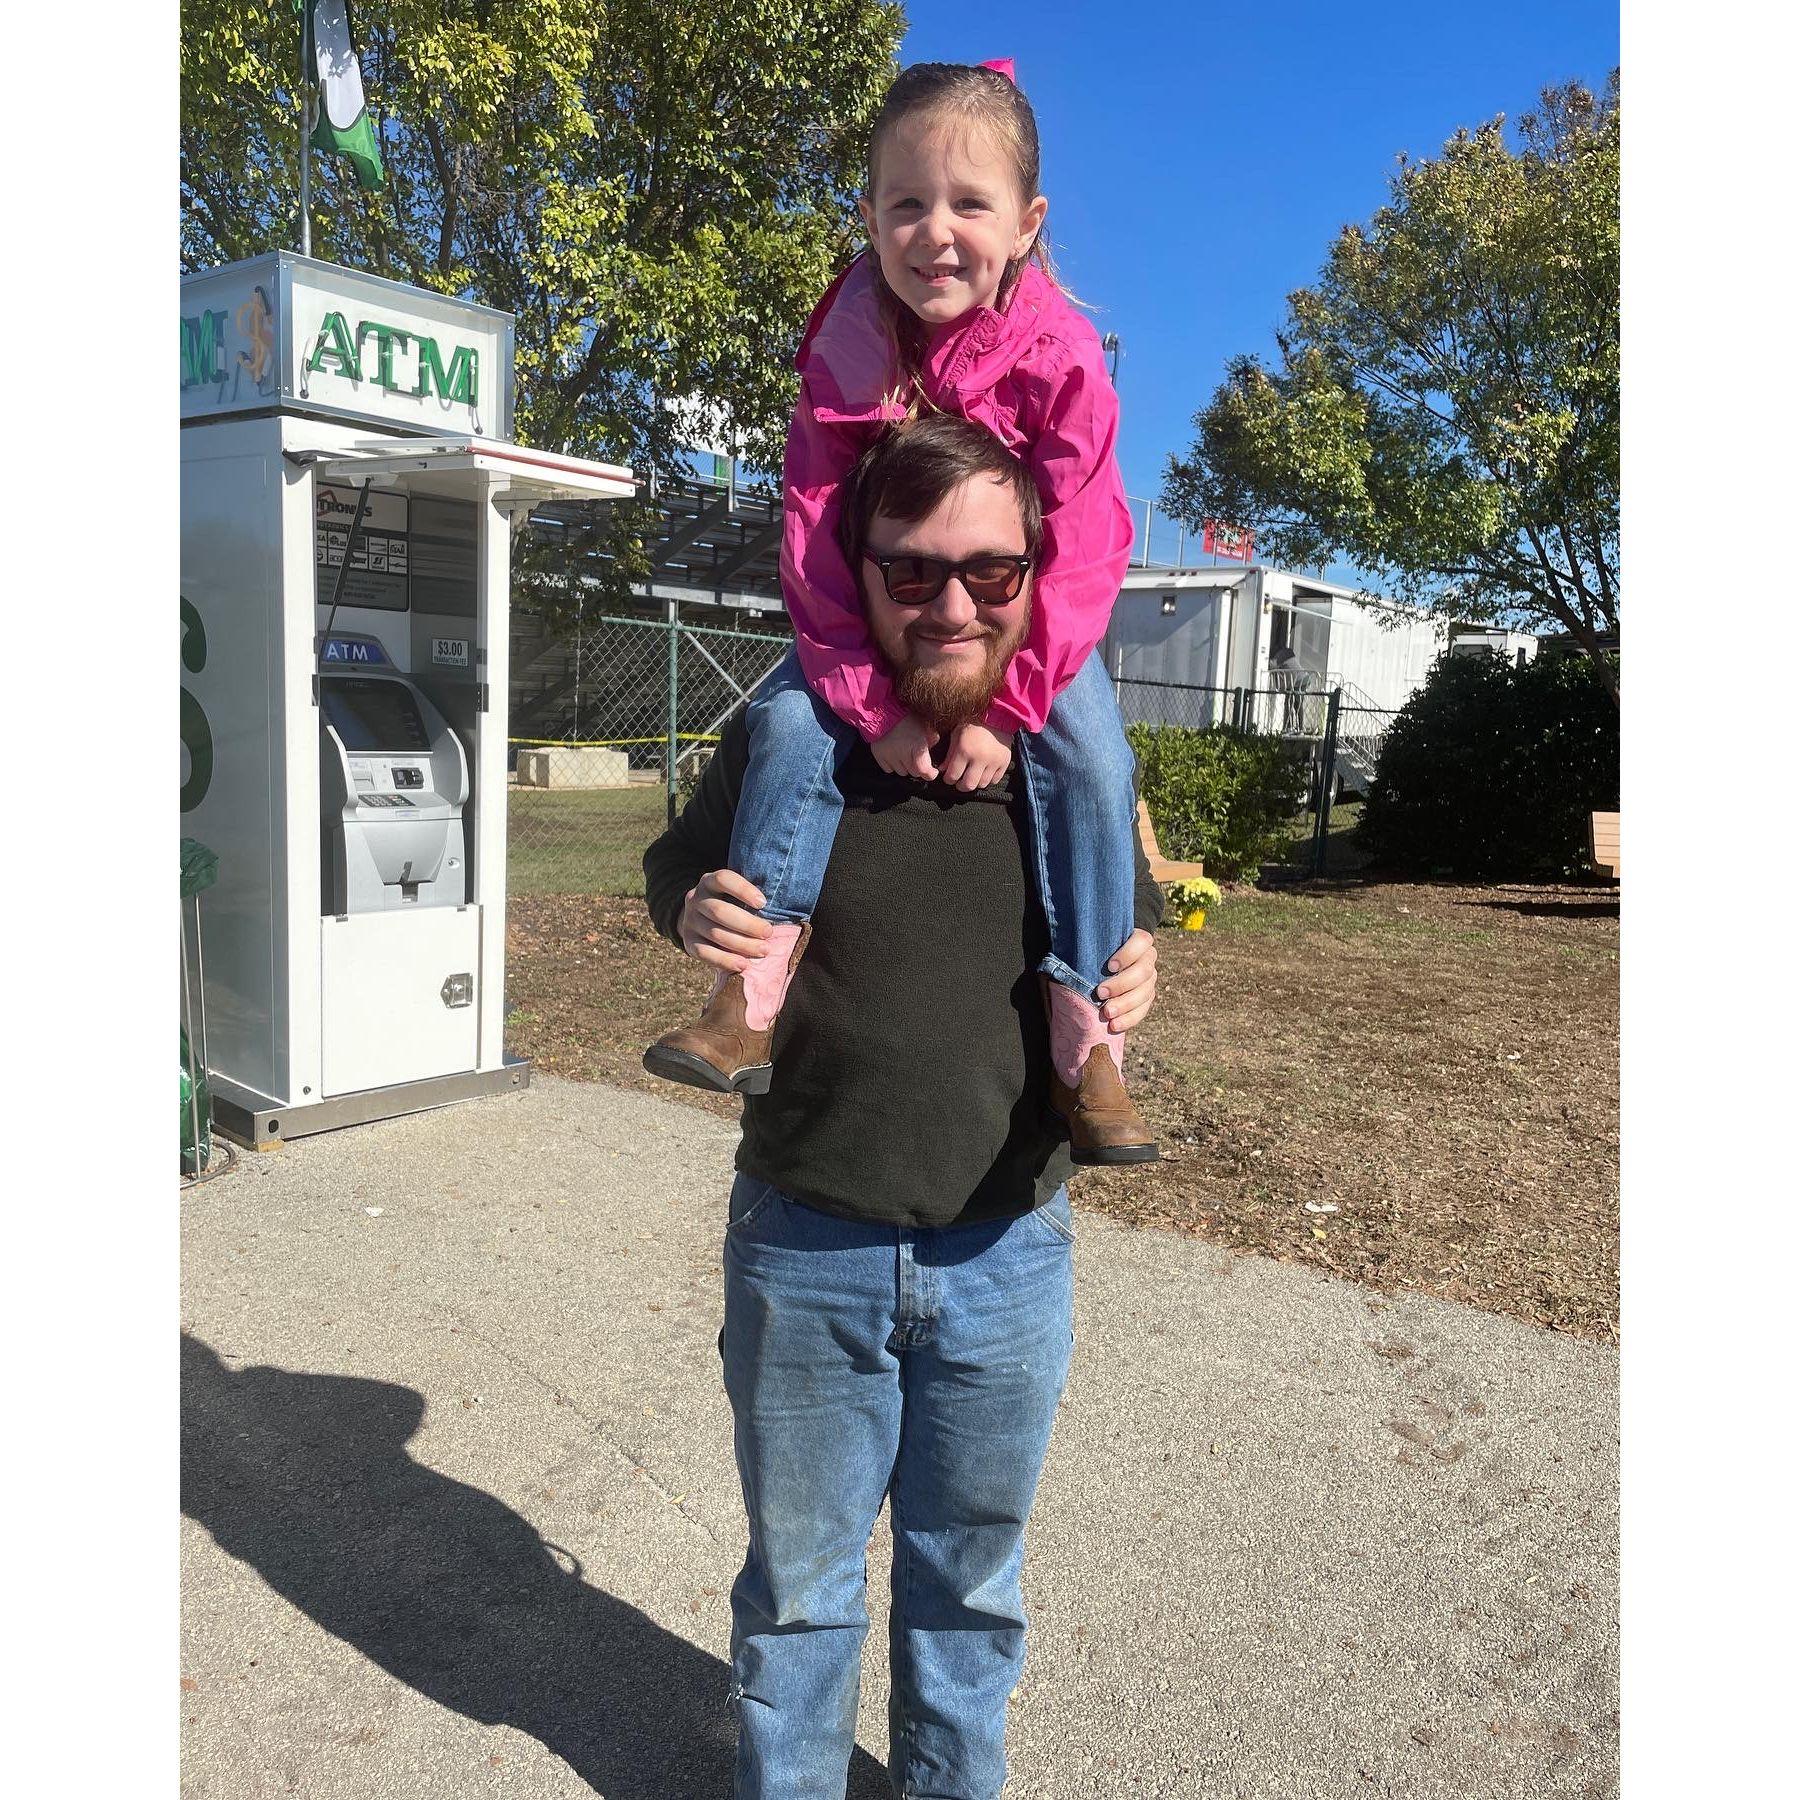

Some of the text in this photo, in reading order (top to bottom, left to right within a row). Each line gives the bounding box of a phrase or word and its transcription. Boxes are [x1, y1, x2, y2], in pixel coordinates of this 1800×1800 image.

[306, 311, 479, 406] ATM
[326, 643, 369, 661] ATM
[437, 641, 463, 656] $3.00
